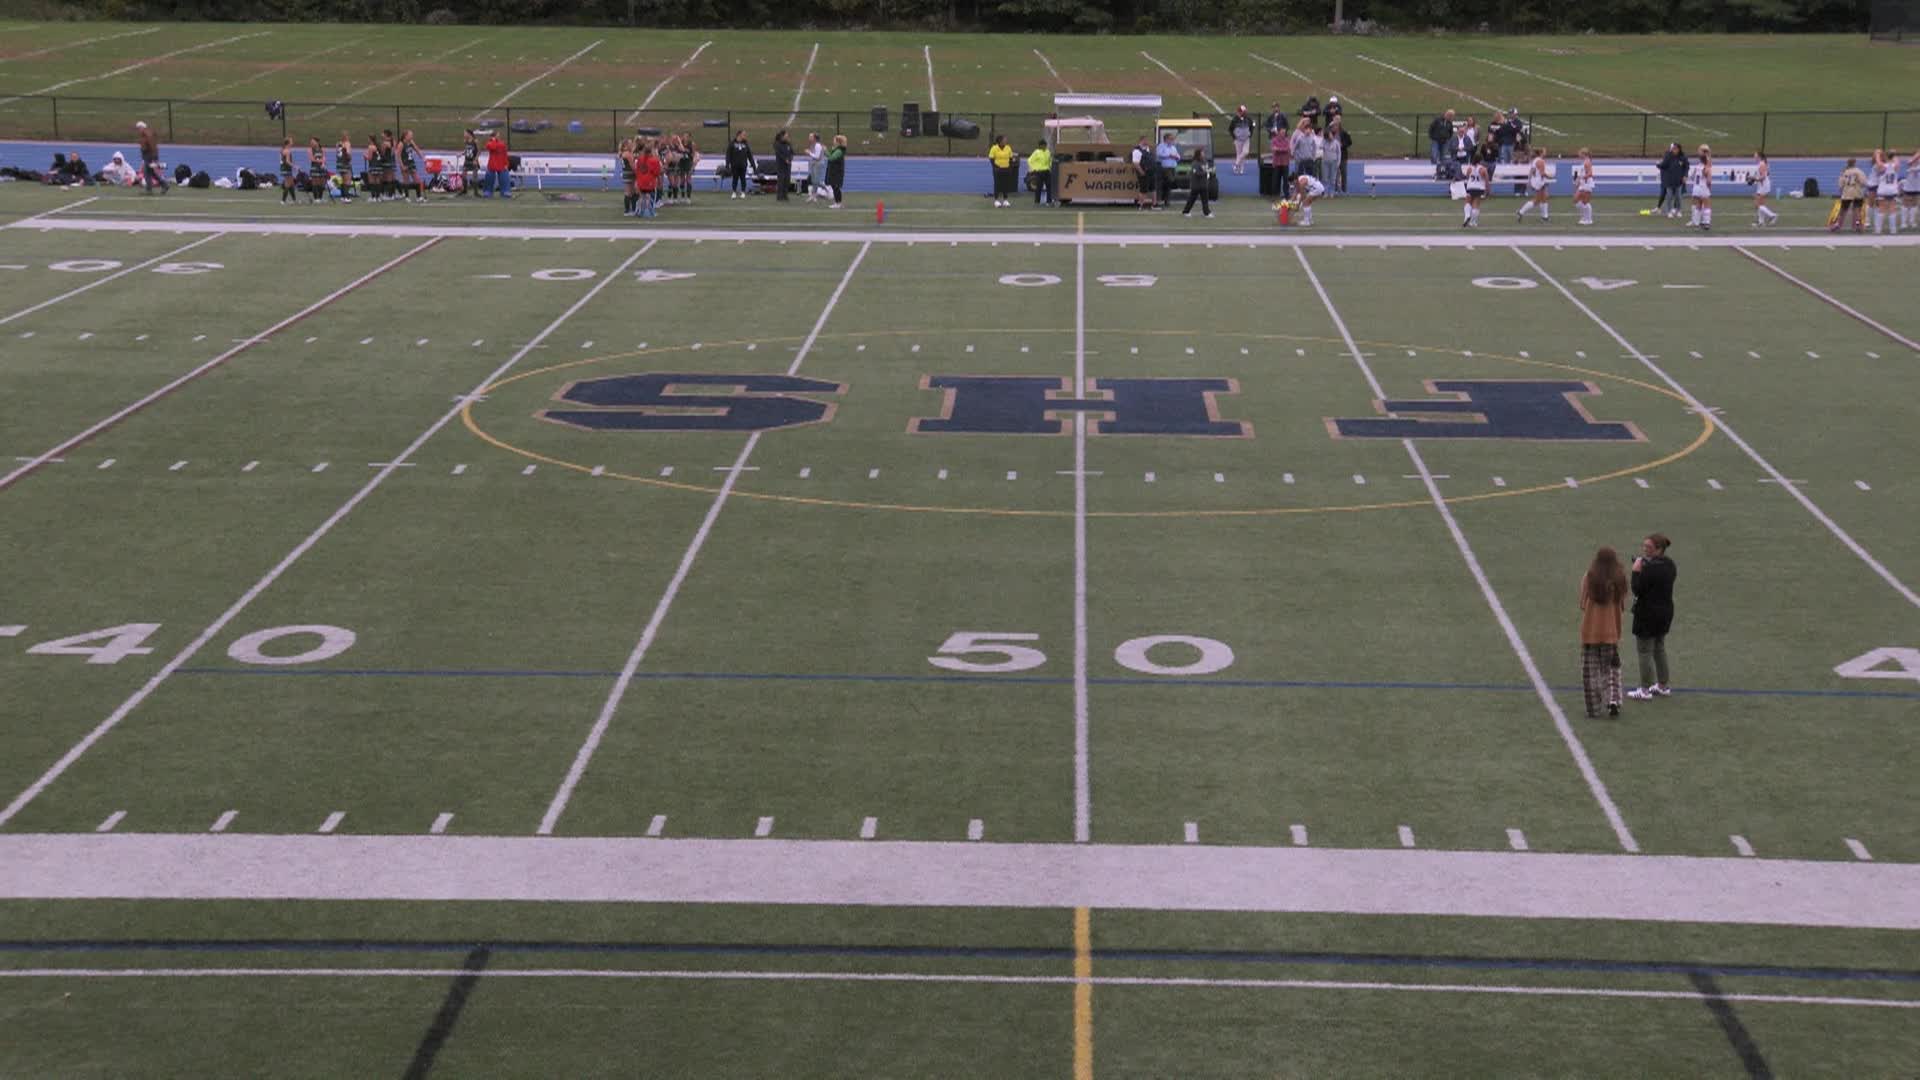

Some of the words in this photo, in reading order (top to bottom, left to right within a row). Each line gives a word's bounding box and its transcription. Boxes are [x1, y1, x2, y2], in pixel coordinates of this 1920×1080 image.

[1087, 167, 1114, 175] HOME
[1116, 167, 1127, 175] OF
[25, 623, 357, 664] 40
[927, 631, 1235, 675] 50
